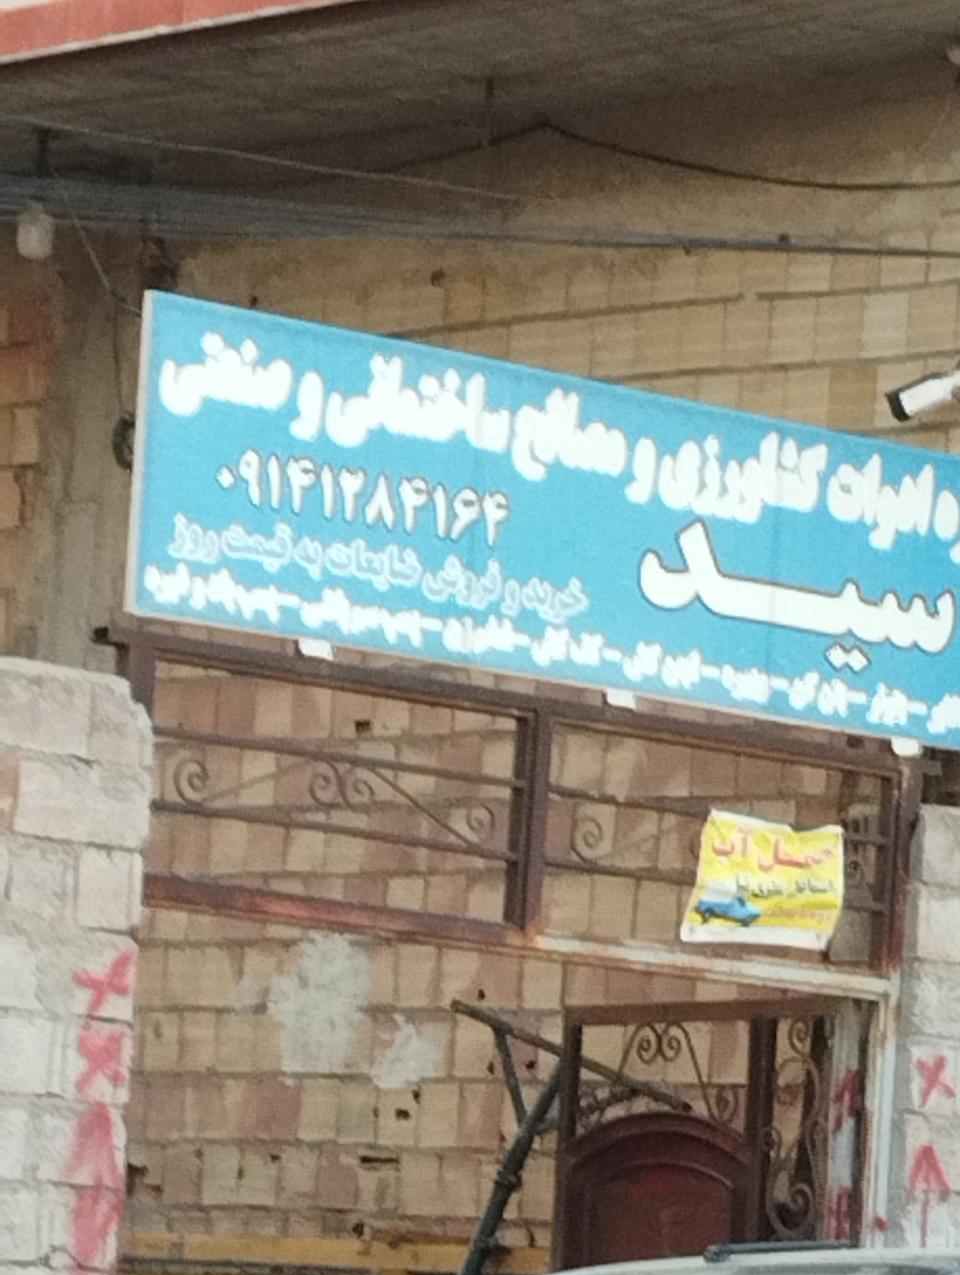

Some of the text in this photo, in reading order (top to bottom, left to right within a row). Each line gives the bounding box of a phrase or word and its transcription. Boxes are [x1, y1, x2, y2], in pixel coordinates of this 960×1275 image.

[159, 331, 293, 416] صنعتی
[289, 370, 324, 442] و
[325, 352, 512, 453] ساختمانی
[511, 388, 628, 482] مصالح
[625, 437, 657, 504] و
[216, 448, 511, 547] ۰۹۱۴۱۲۸۴۱۶۴
[658, 431, 828, 523] کشاورزی
[220, 521, 294, 574] قیمت
[421, 553, 502, 611] فروش
[500, 578, 521, 618] و
[521, 576, 590, 624] خرید
